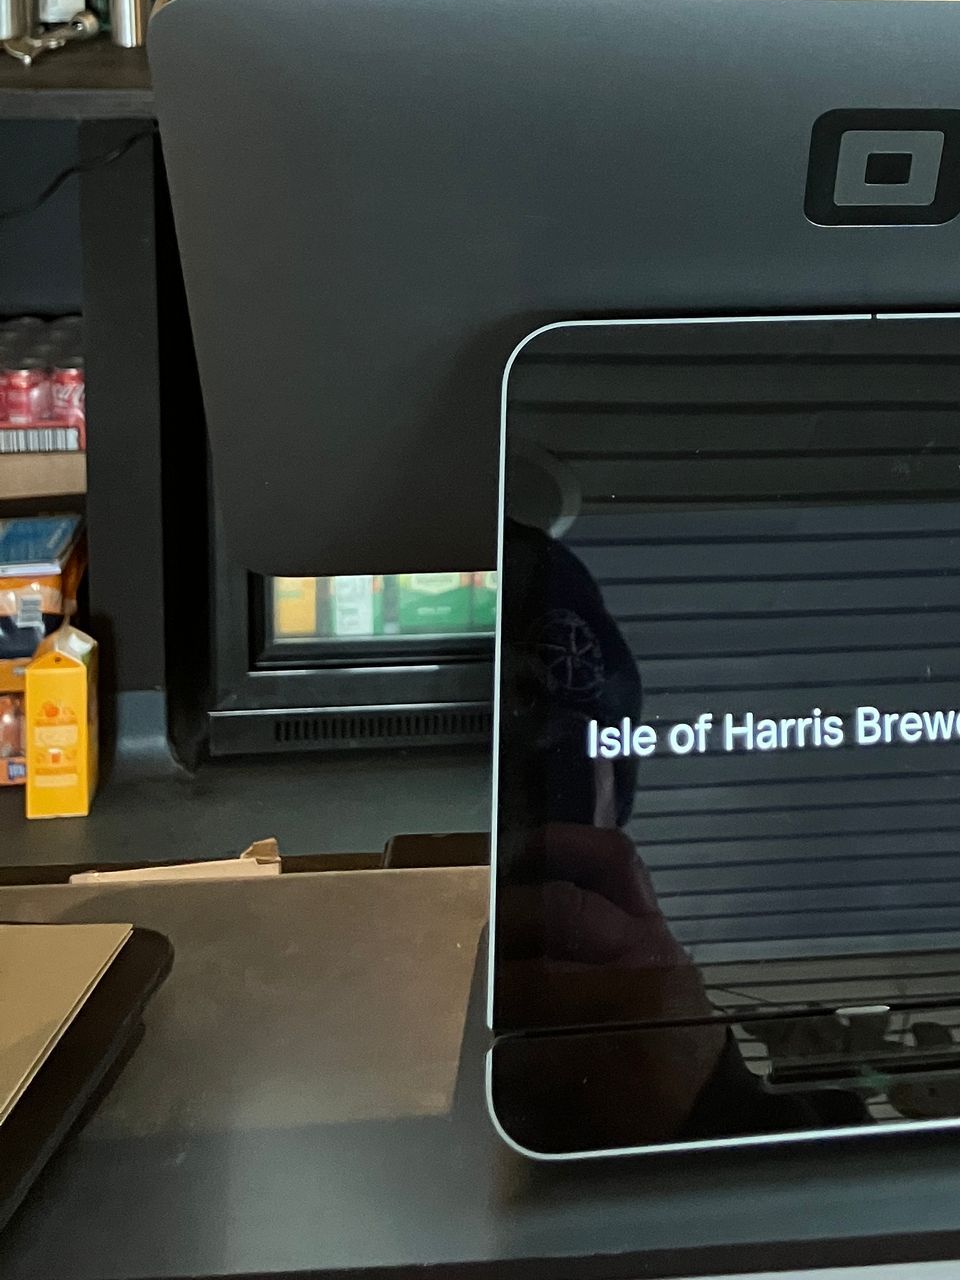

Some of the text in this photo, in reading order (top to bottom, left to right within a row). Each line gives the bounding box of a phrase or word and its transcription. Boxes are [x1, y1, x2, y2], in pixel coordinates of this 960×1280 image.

[586, 719, 657, 759] Isle
[668, 713, 713, 755] of
[723, 708, 844, 753] Harris
